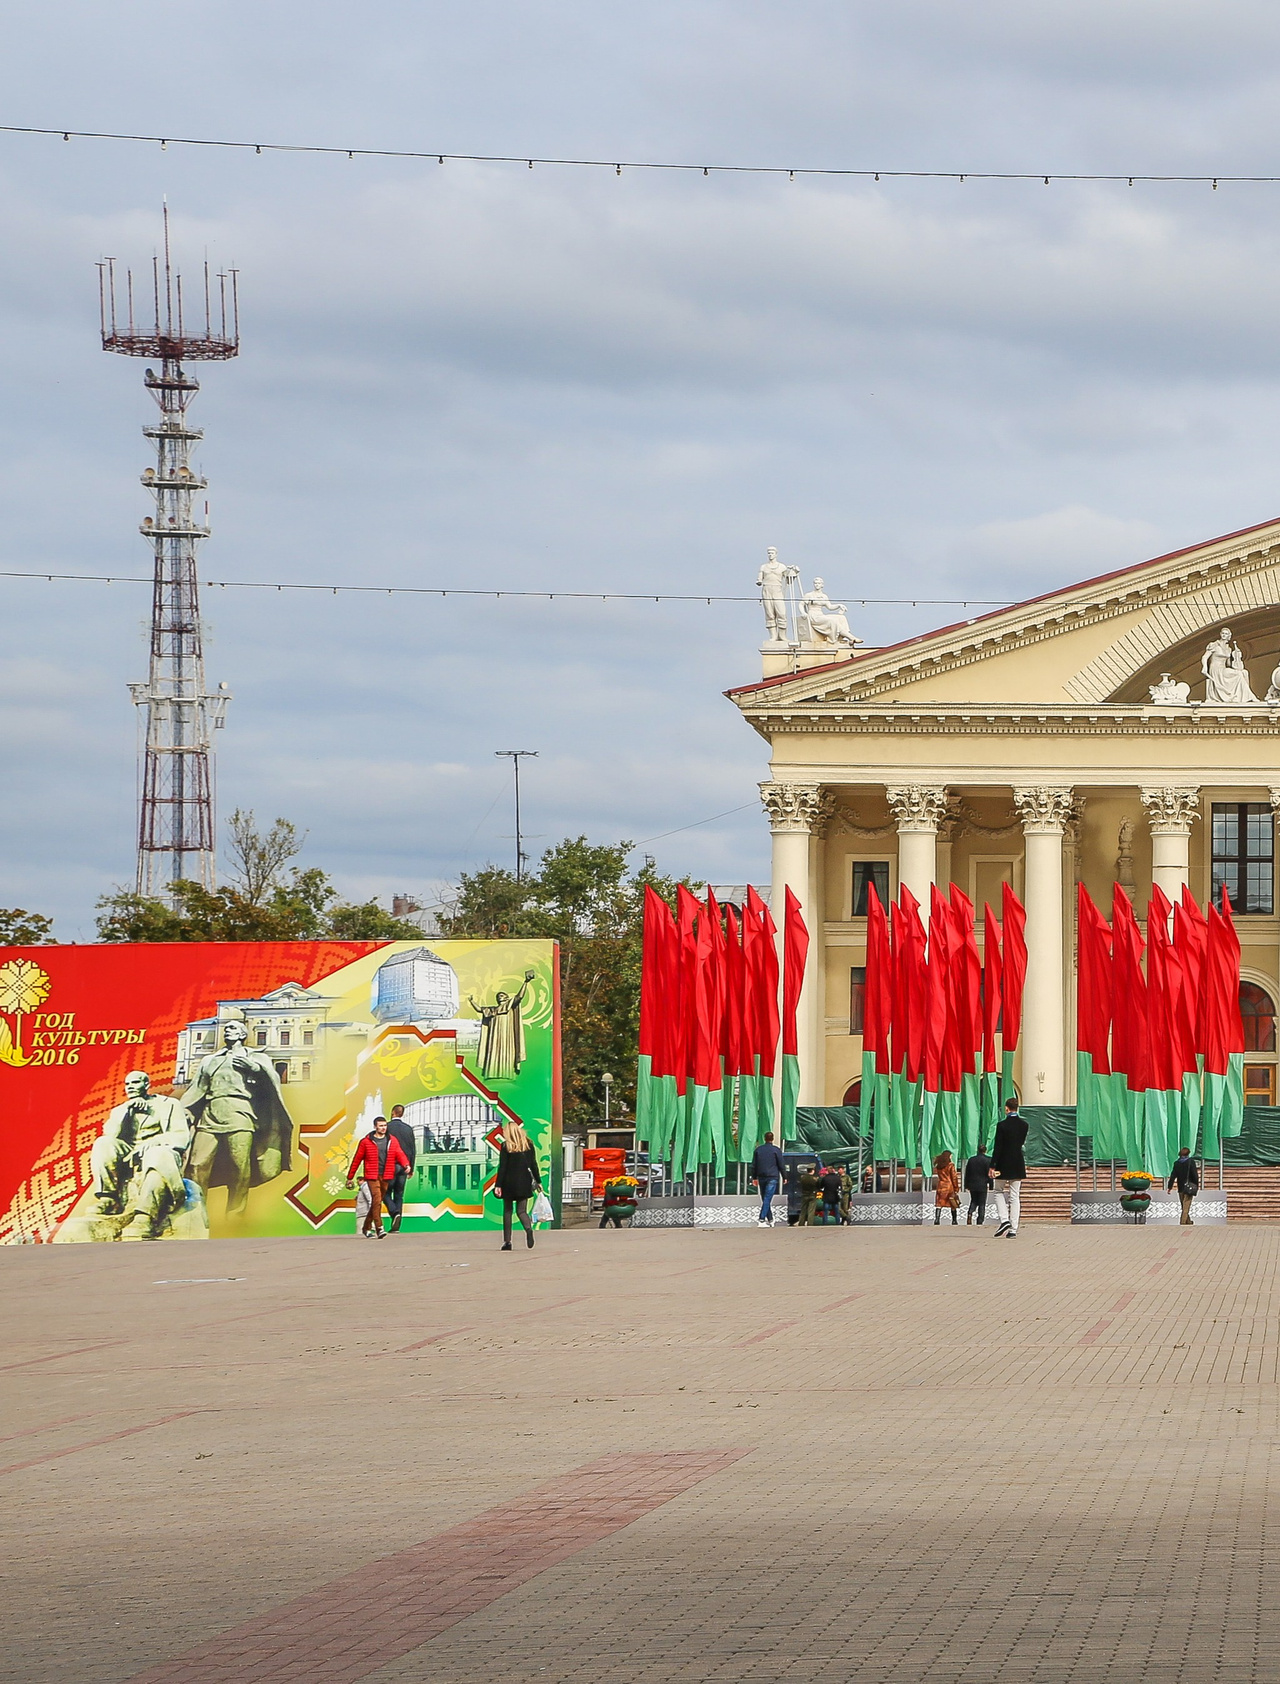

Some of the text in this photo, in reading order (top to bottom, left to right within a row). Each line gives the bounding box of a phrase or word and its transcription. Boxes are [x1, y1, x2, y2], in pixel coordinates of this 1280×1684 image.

[33, 1012, 76, 1030] ГОД
[31, 1029, 147, 1047] КУЛЬТУРЫ
[30, 1048, 81, 1066] 2016
